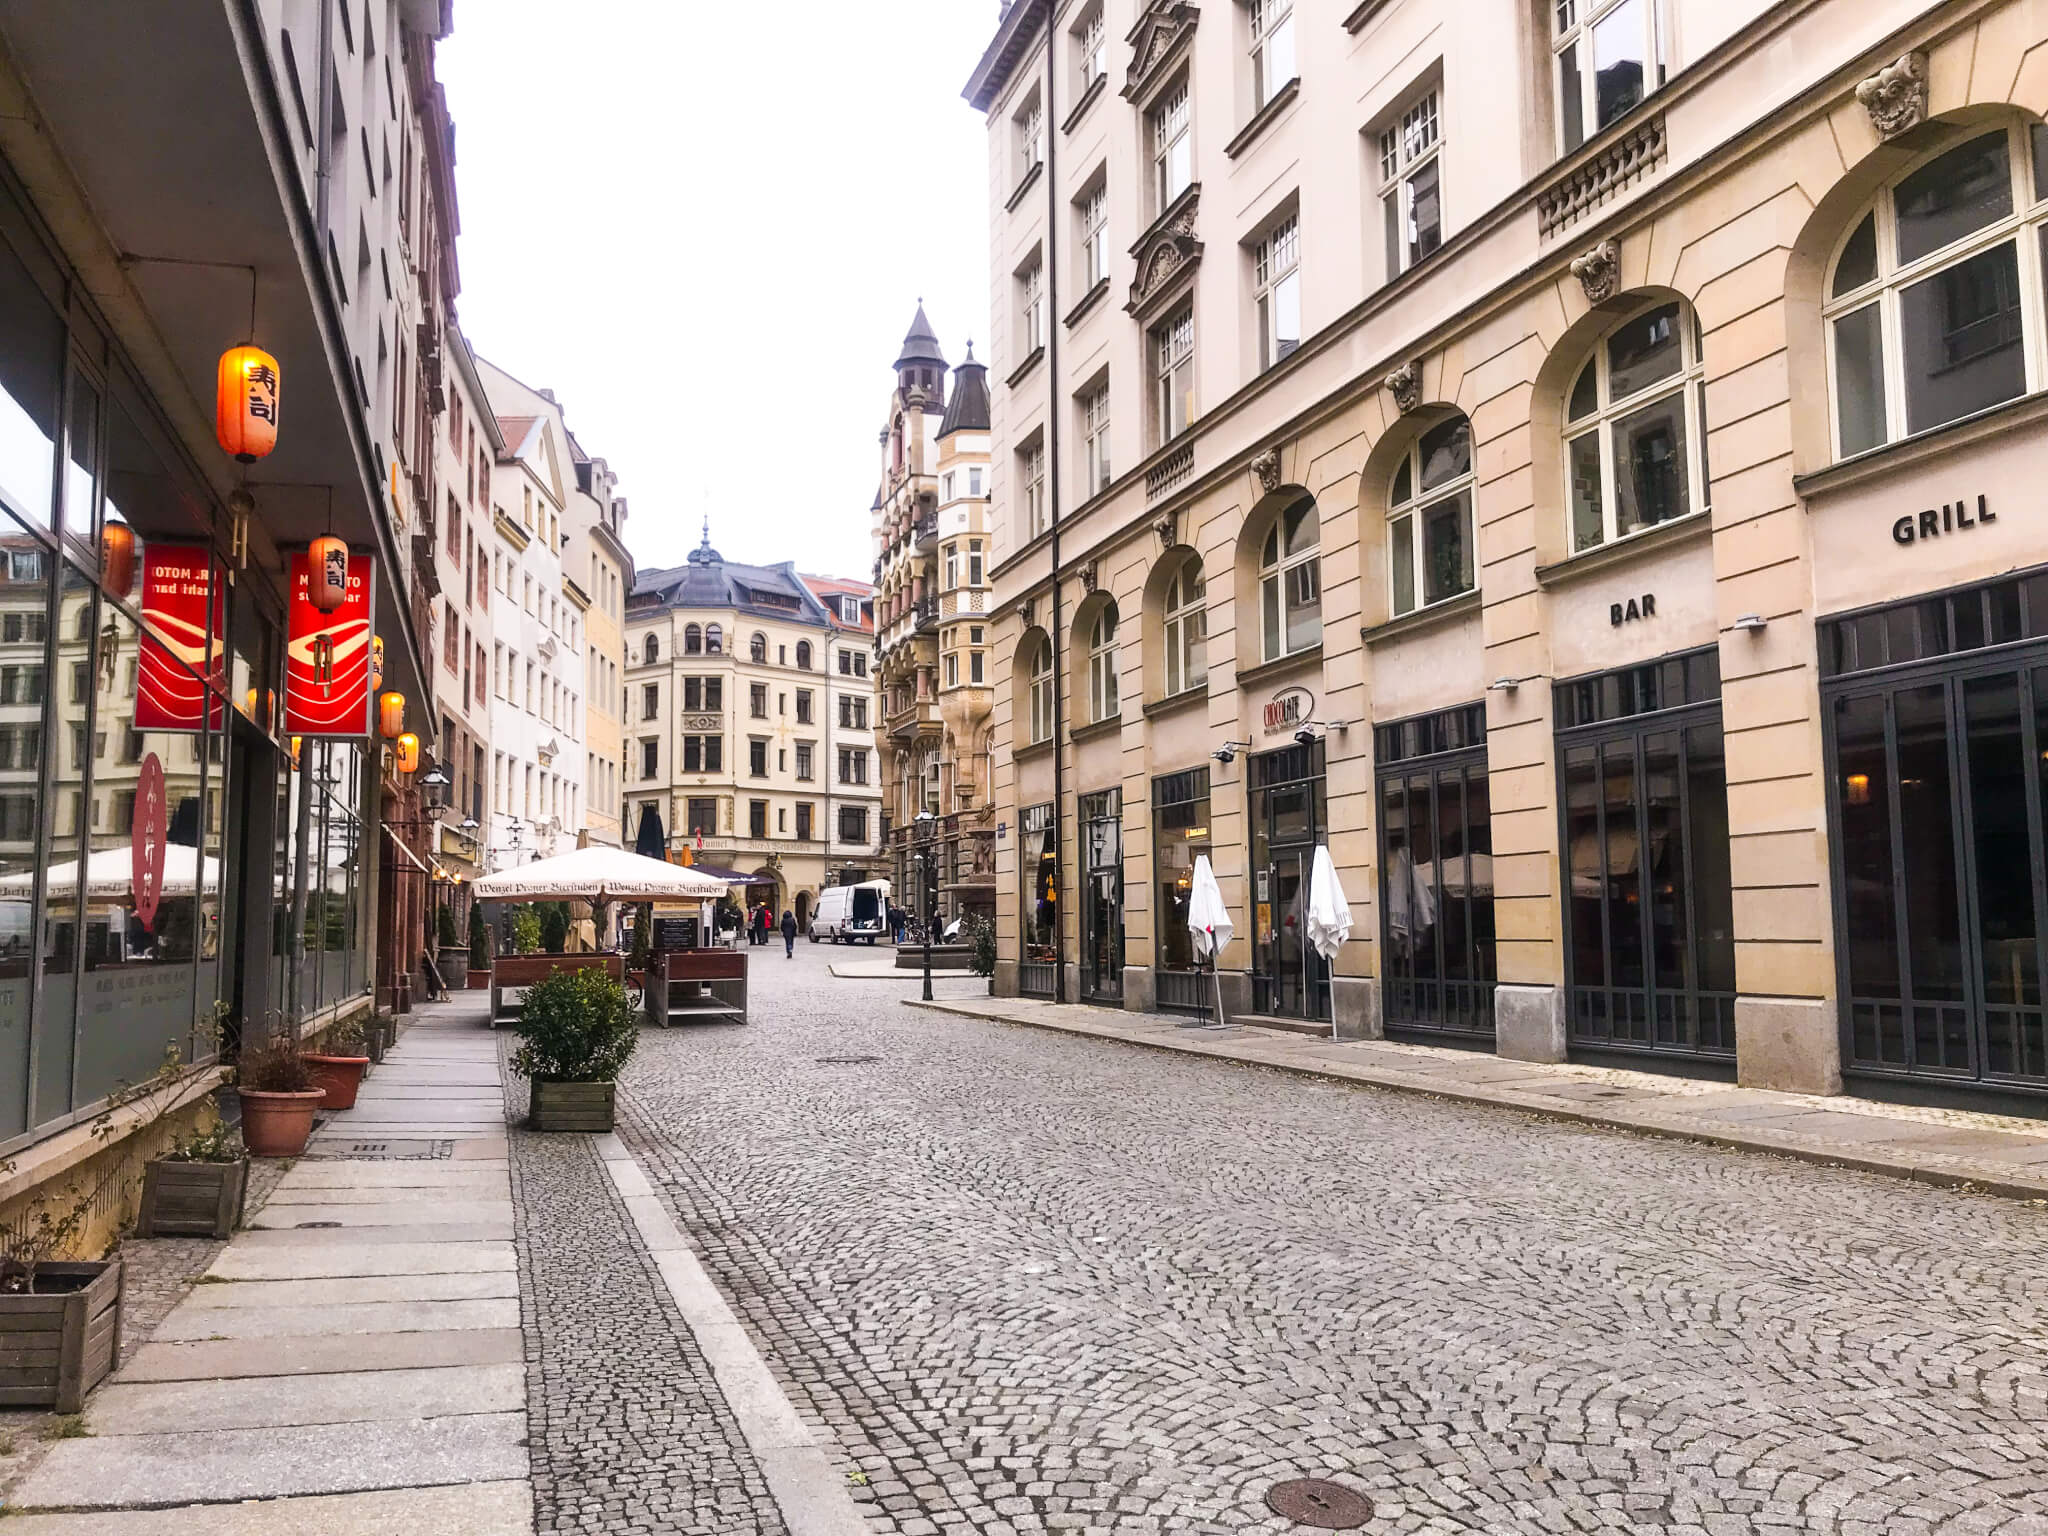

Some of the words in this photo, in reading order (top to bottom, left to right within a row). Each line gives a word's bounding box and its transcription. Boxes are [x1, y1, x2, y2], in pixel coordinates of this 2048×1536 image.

[1892, 494, 1996, 544] GRILL
[1610, 594, 1656, 627] BAR
[1264, 695, 1299, 728] CHOCOLATE
[480, 883, 513, 895] Wenzel
[609, 882, 642, 894] Wenzel
